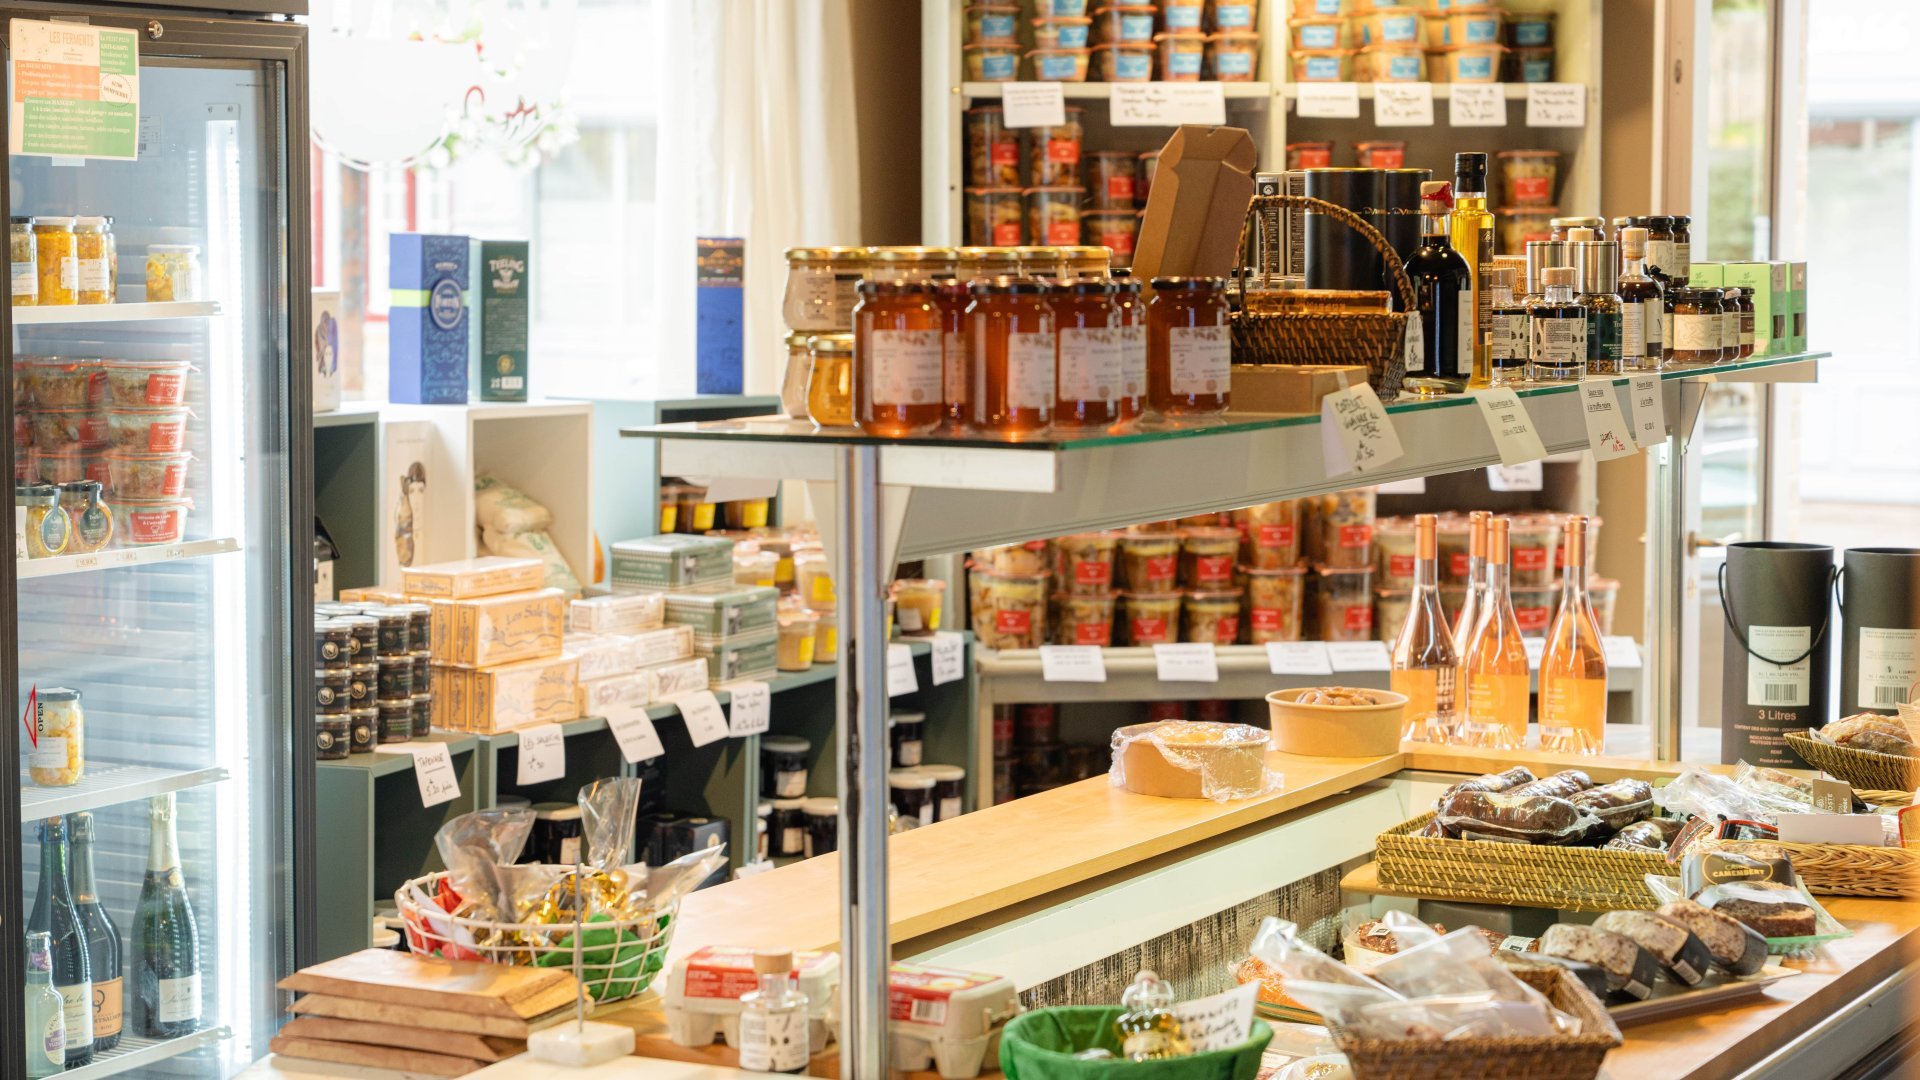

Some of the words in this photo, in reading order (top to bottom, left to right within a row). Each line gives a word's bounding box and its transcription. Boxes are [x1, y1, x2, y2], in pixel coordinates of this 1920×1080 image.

[49, 31, 60, 43] LES
[62, 33, 95, 47] FERMENTS
[1758, 709, 1766, 720] 3
[1767, 710, 1797, 721] Litres
[1712, 868, 1765, 878] CAMEMBERT
